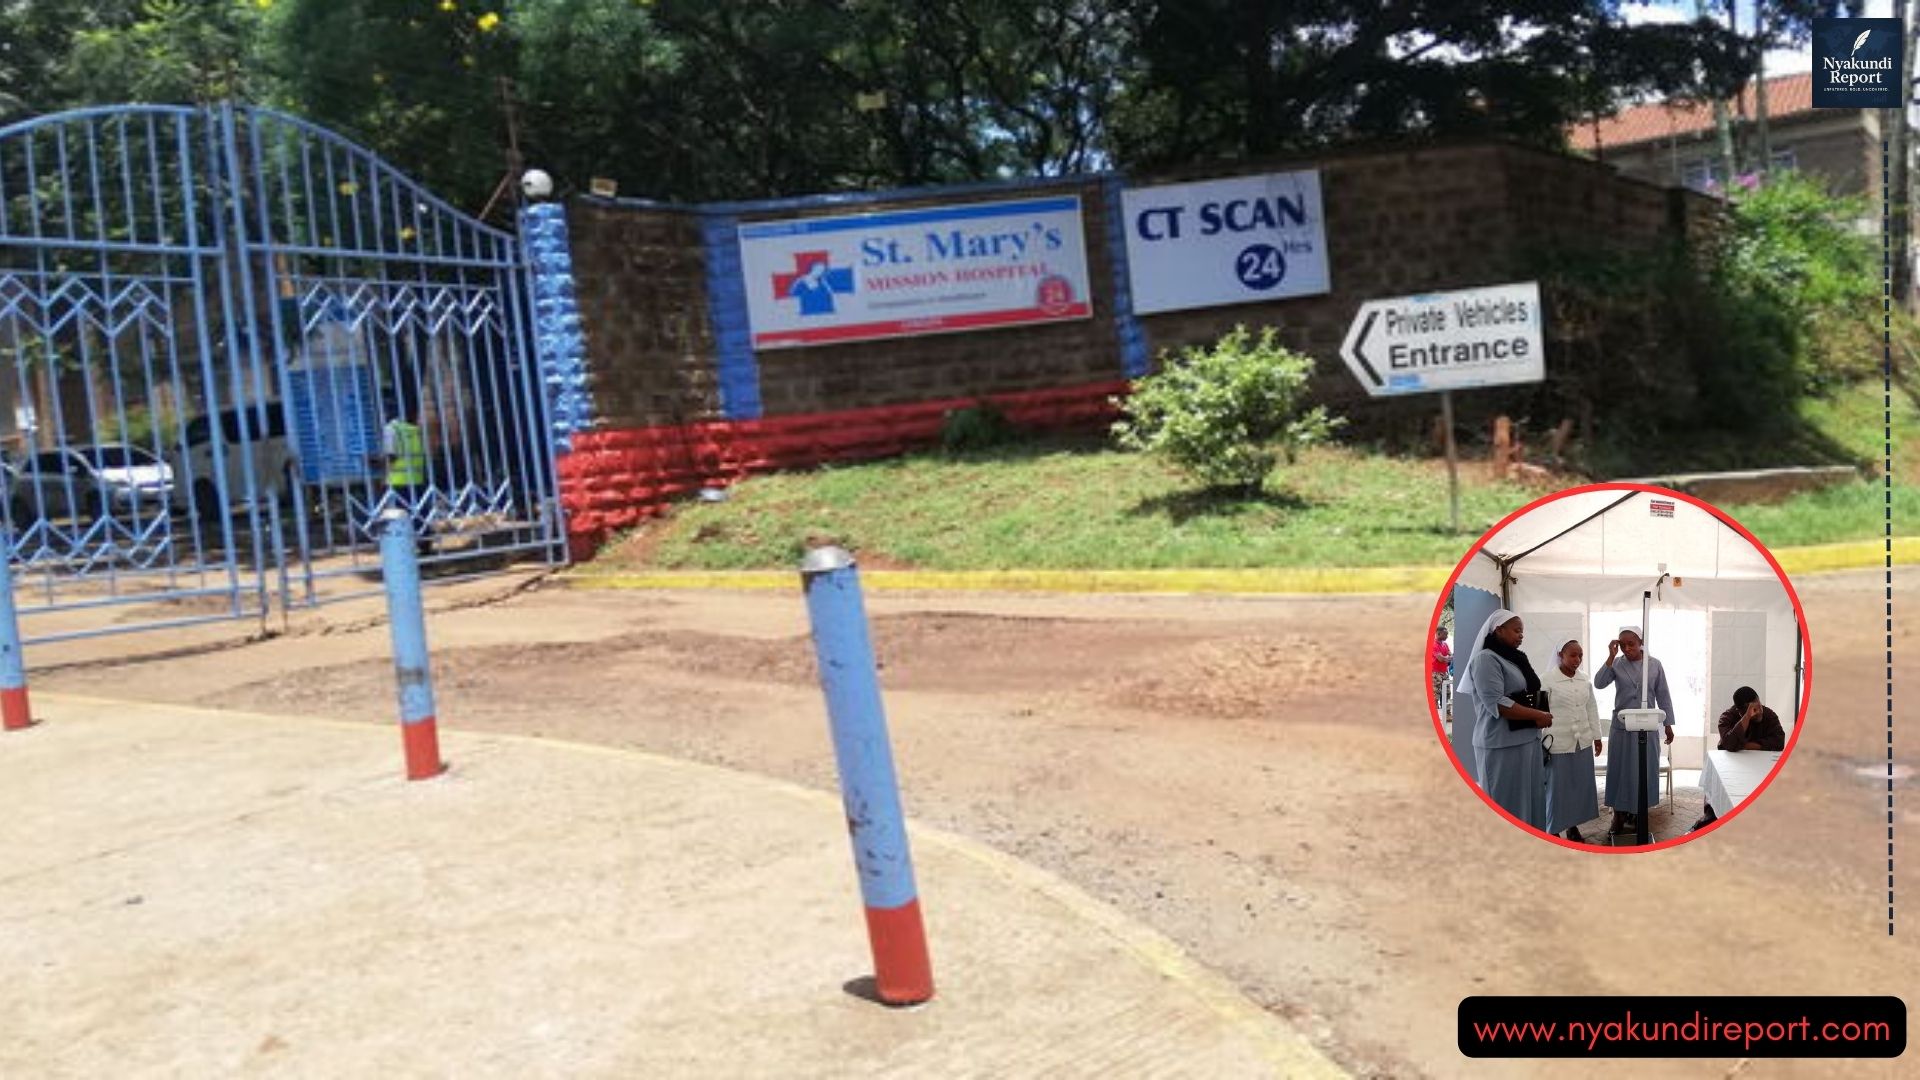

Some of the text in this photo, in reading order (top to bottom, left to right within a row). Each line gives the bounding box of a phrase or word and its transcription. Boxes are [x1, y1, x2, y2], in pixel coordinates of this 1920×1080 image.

[1136, 193, 1307, 241] CT SCAN
[861, 221, 1063, 267] St. Mary's
[865, 261, 1048, 292] MISSION HOSPITAL
[1241, 251, 1281, 282] 24
[1385, 298, 1529, 336] Private Vehicles
[1388, 336, 1529, 369] Entrance
